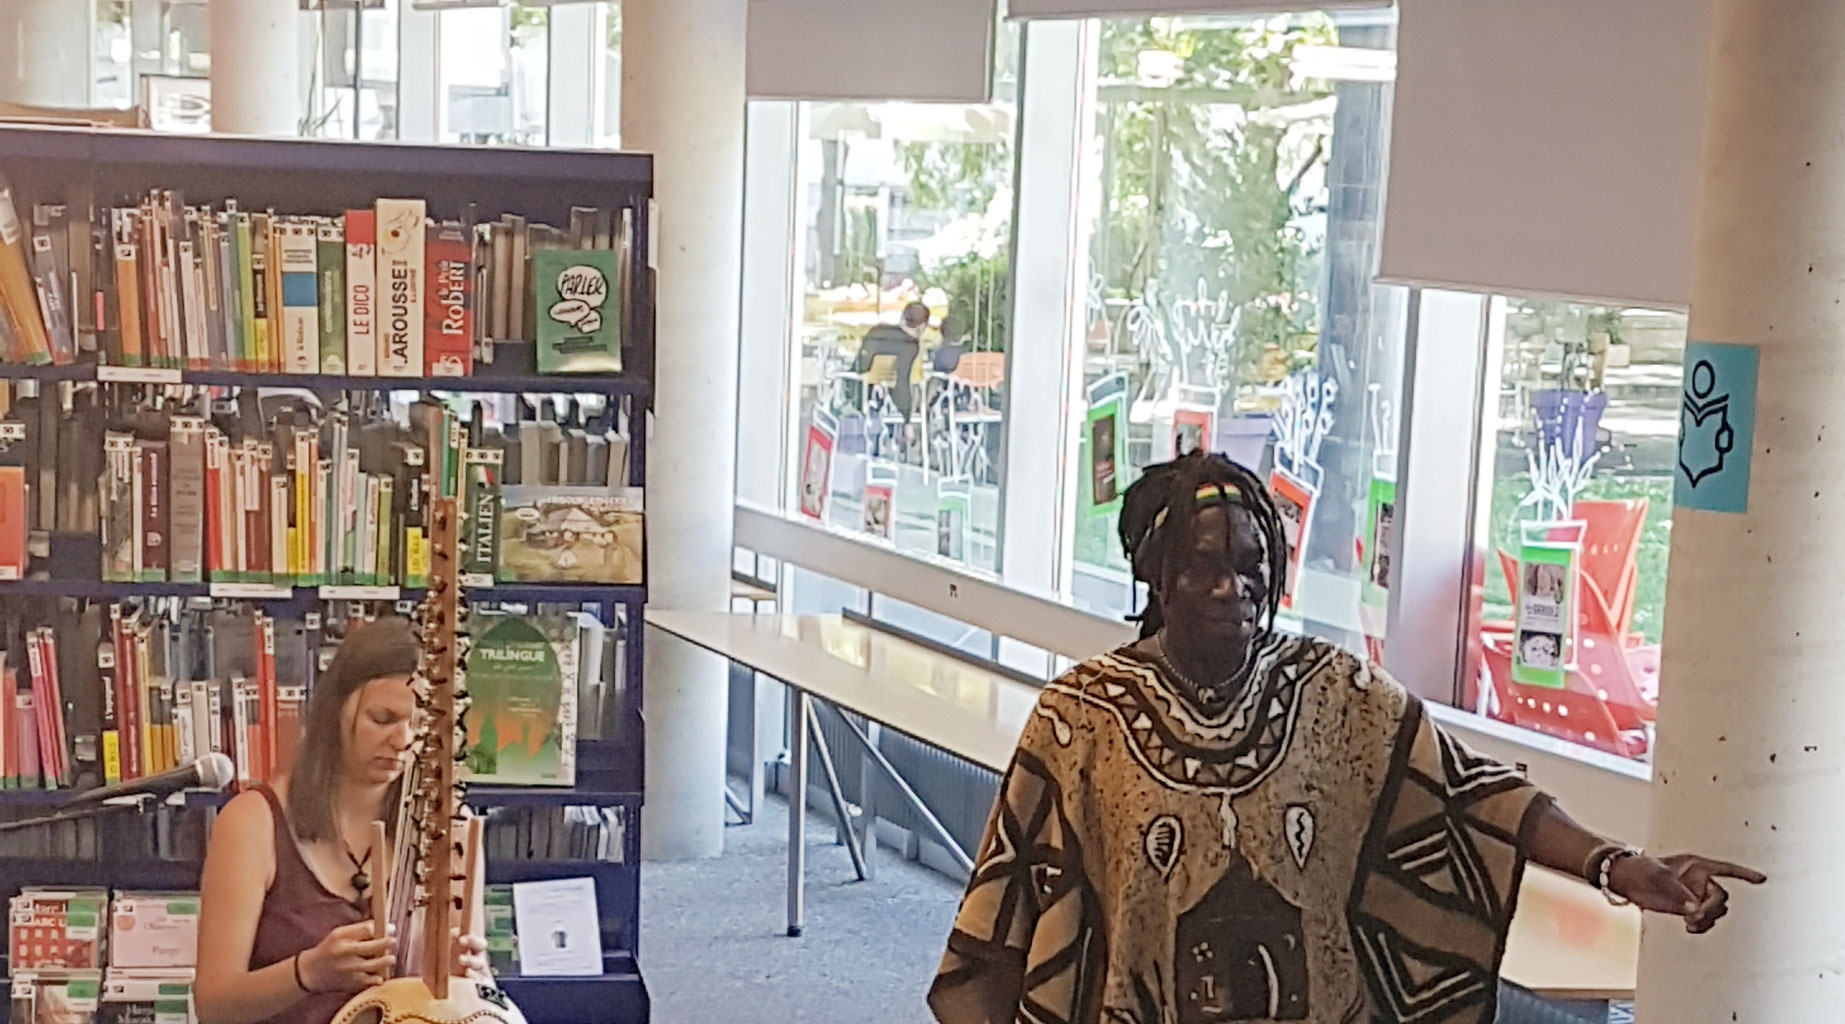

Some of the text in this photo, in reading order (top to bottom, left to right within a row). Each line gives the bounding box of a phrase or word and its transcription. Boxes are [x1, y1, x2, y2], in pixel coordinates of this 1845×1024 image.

[561, 273, 604, 296] PARLER
[353, 284, 370, 335] LE DICO
[476, 492, 495, 564] ITALIEN
[479, 648, 545, 662] TRILINGUE
